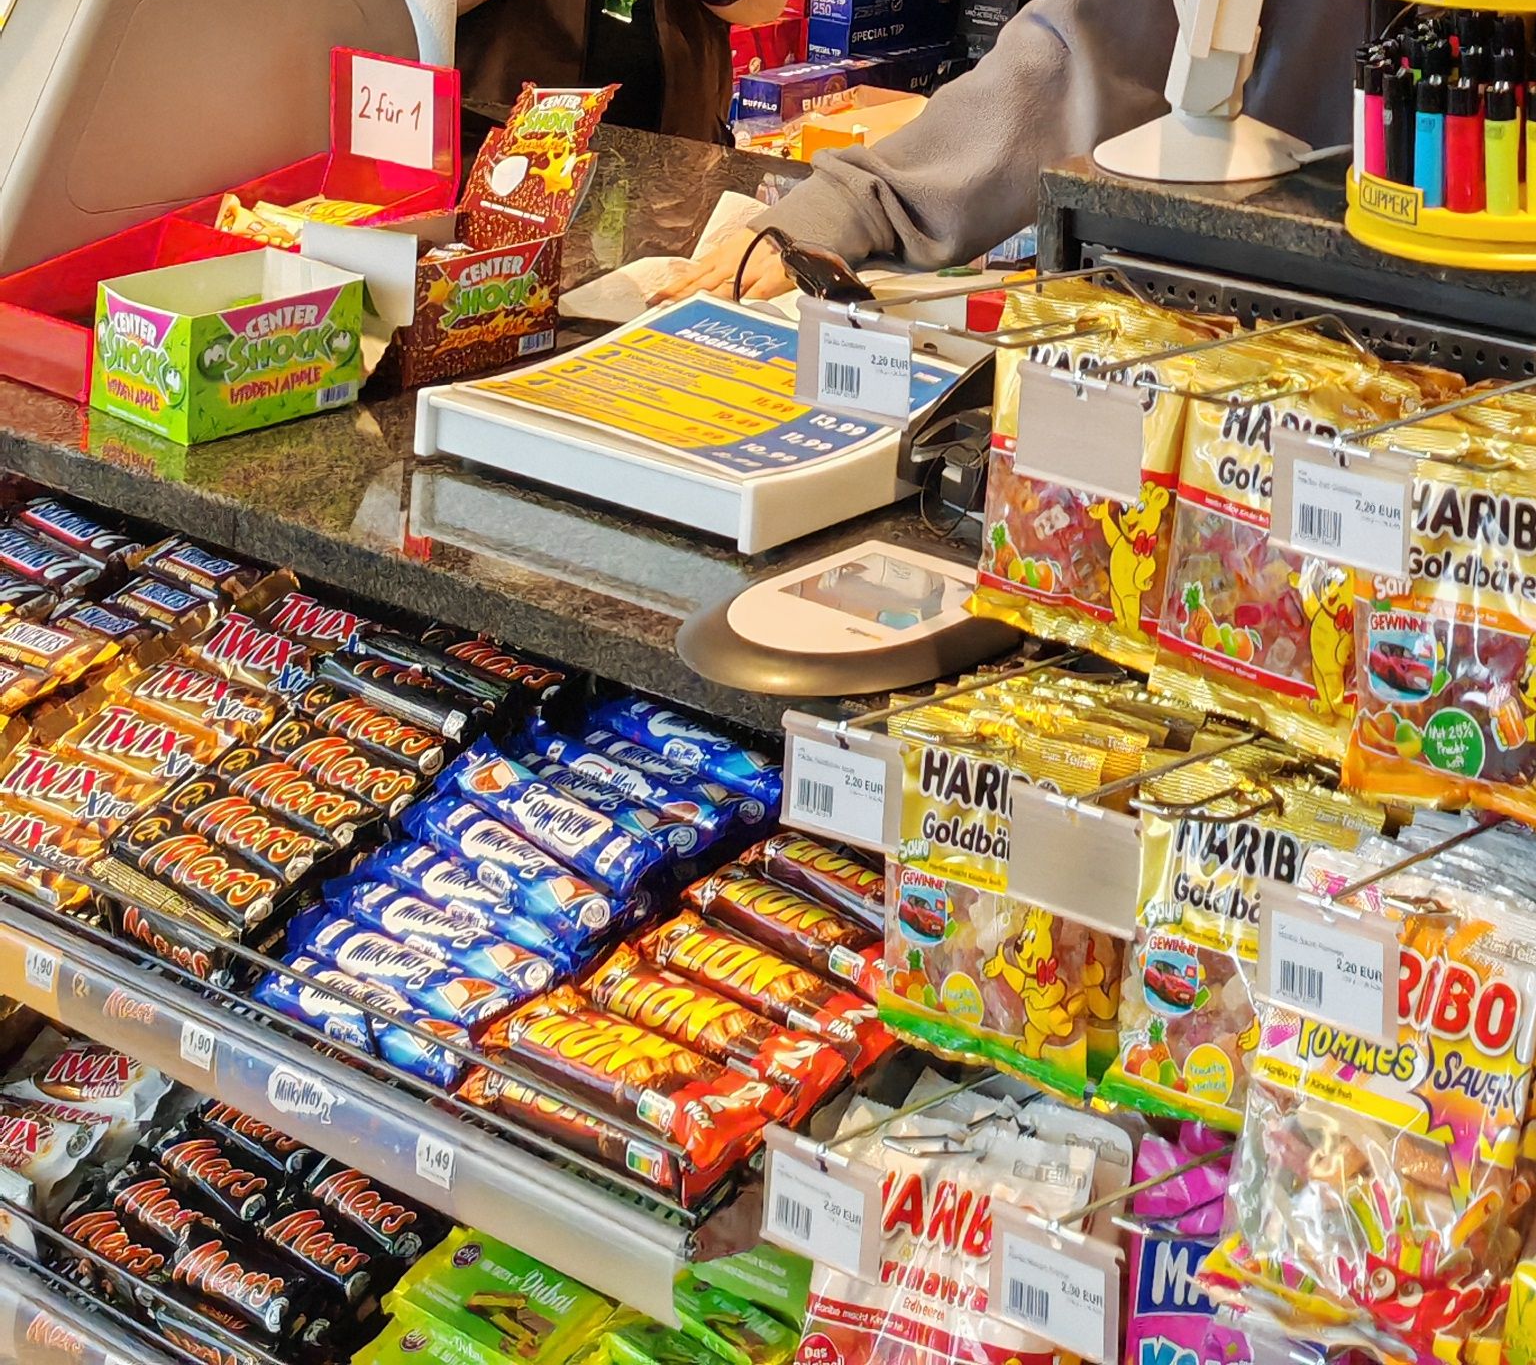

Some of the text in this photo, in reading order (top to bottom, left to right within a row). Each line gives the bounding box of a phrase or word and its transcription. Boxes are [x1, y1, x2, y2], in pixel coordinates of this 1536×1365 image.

[358, 85, 422, 132] 2 für 1
[1362, 187, 1416, 224] CLIPPER
[245, 303, 319, 337] CENTER
[673, 328, 764, 360] PROGRAMM
[690, 316, 790, 354] WASCH
[224, 322, 338, 383] SHOCK
[229, 367, 322, 405] HIDDEN APPLE
[2, 623, 74, 655] SNICKERS
[315, 697, 443, 755] Mars
[229, 761, 361, 826] Mars
[285, 736, 415, 804] Mars
[865, 779, 884, 795] EUR
[185, 795, 318, 862] Mars
[138, 834, 278, 906] Mars
[902, 869, 946, 891] GEWINNE
[728, 877, 832, 930] LION
[680, 931, 780, 997] LION
[1359, 963, 1383, 982] EUR
[611, 975, 728, 1043] LION
[1398, 947, 1520, 1050] RIBO
[321, 1101, 332, 1123] 2
[162, 1139, 267, 1198] Mars
[312, 1170, 417, 1235] Mars
[265, 1209, 371, 1273] Mars
[174, 1239, 284, 1307] Mars
